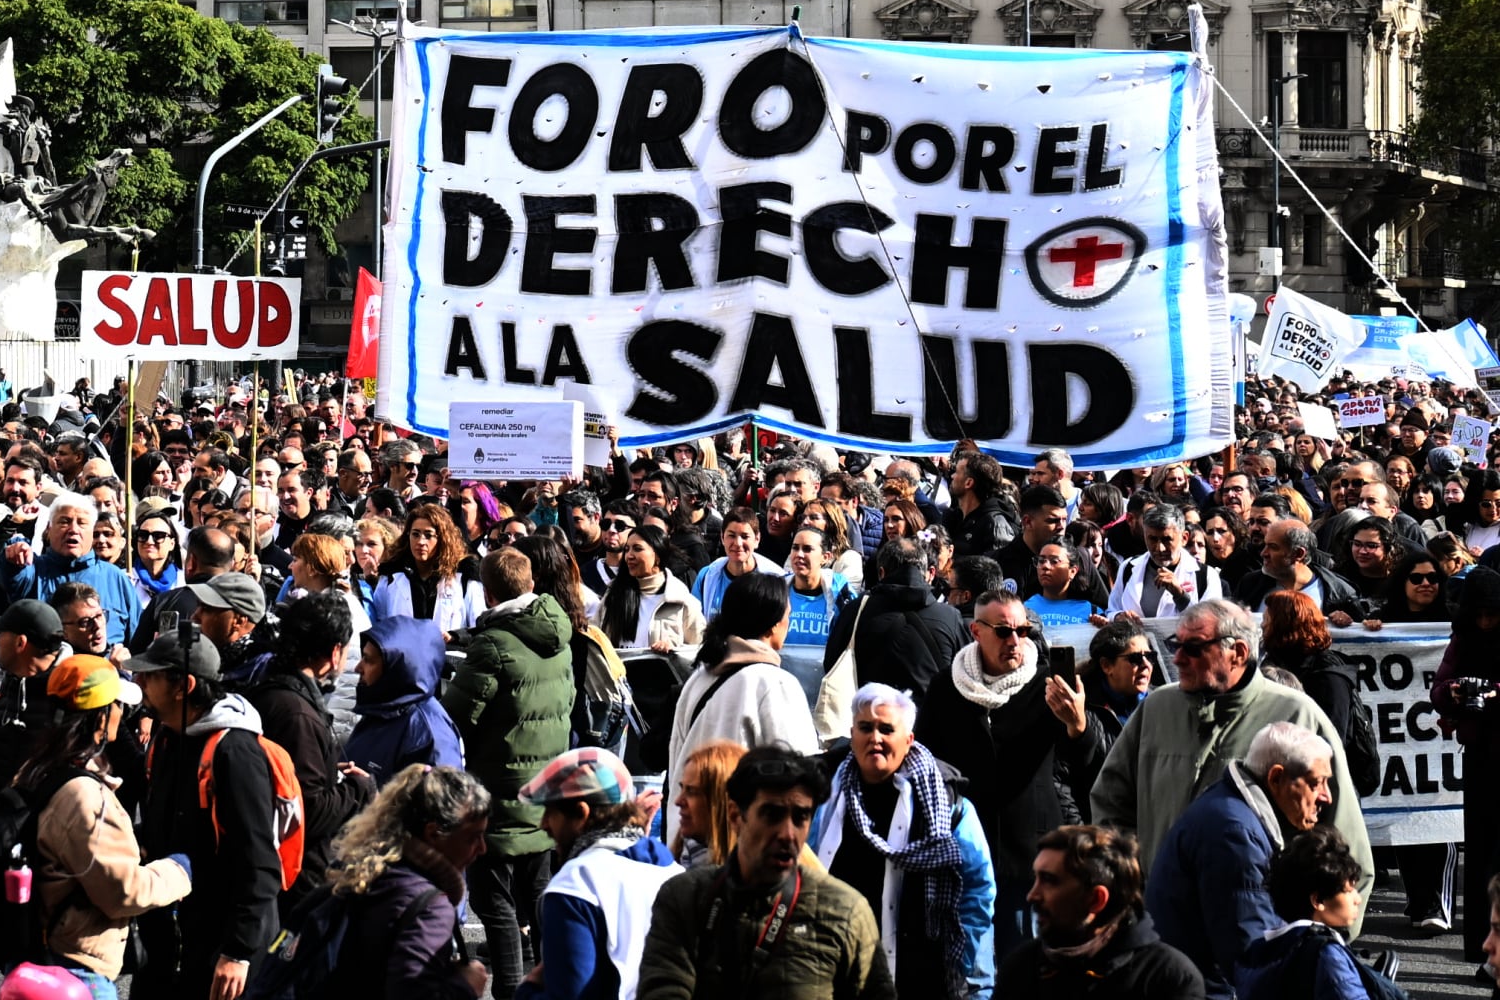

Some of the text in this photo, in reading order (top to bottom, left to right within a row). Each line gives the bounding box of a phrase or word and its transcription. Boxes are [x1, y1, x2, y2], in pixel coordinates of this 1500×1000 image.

[440, 48, 1125, 195] FORO POR EL
[93, 274, 292, 349] SALUD
[1286, 317, 1317, 338] FORO
[444, 311, 1137, 447] A LA SALUD
[459, 423, 507, 431] CEFALEXINA
[508, 423, 523, 431] 250
[787, 619, 829, 636] ALUD
[1350, 653, 1414, 693] RO
